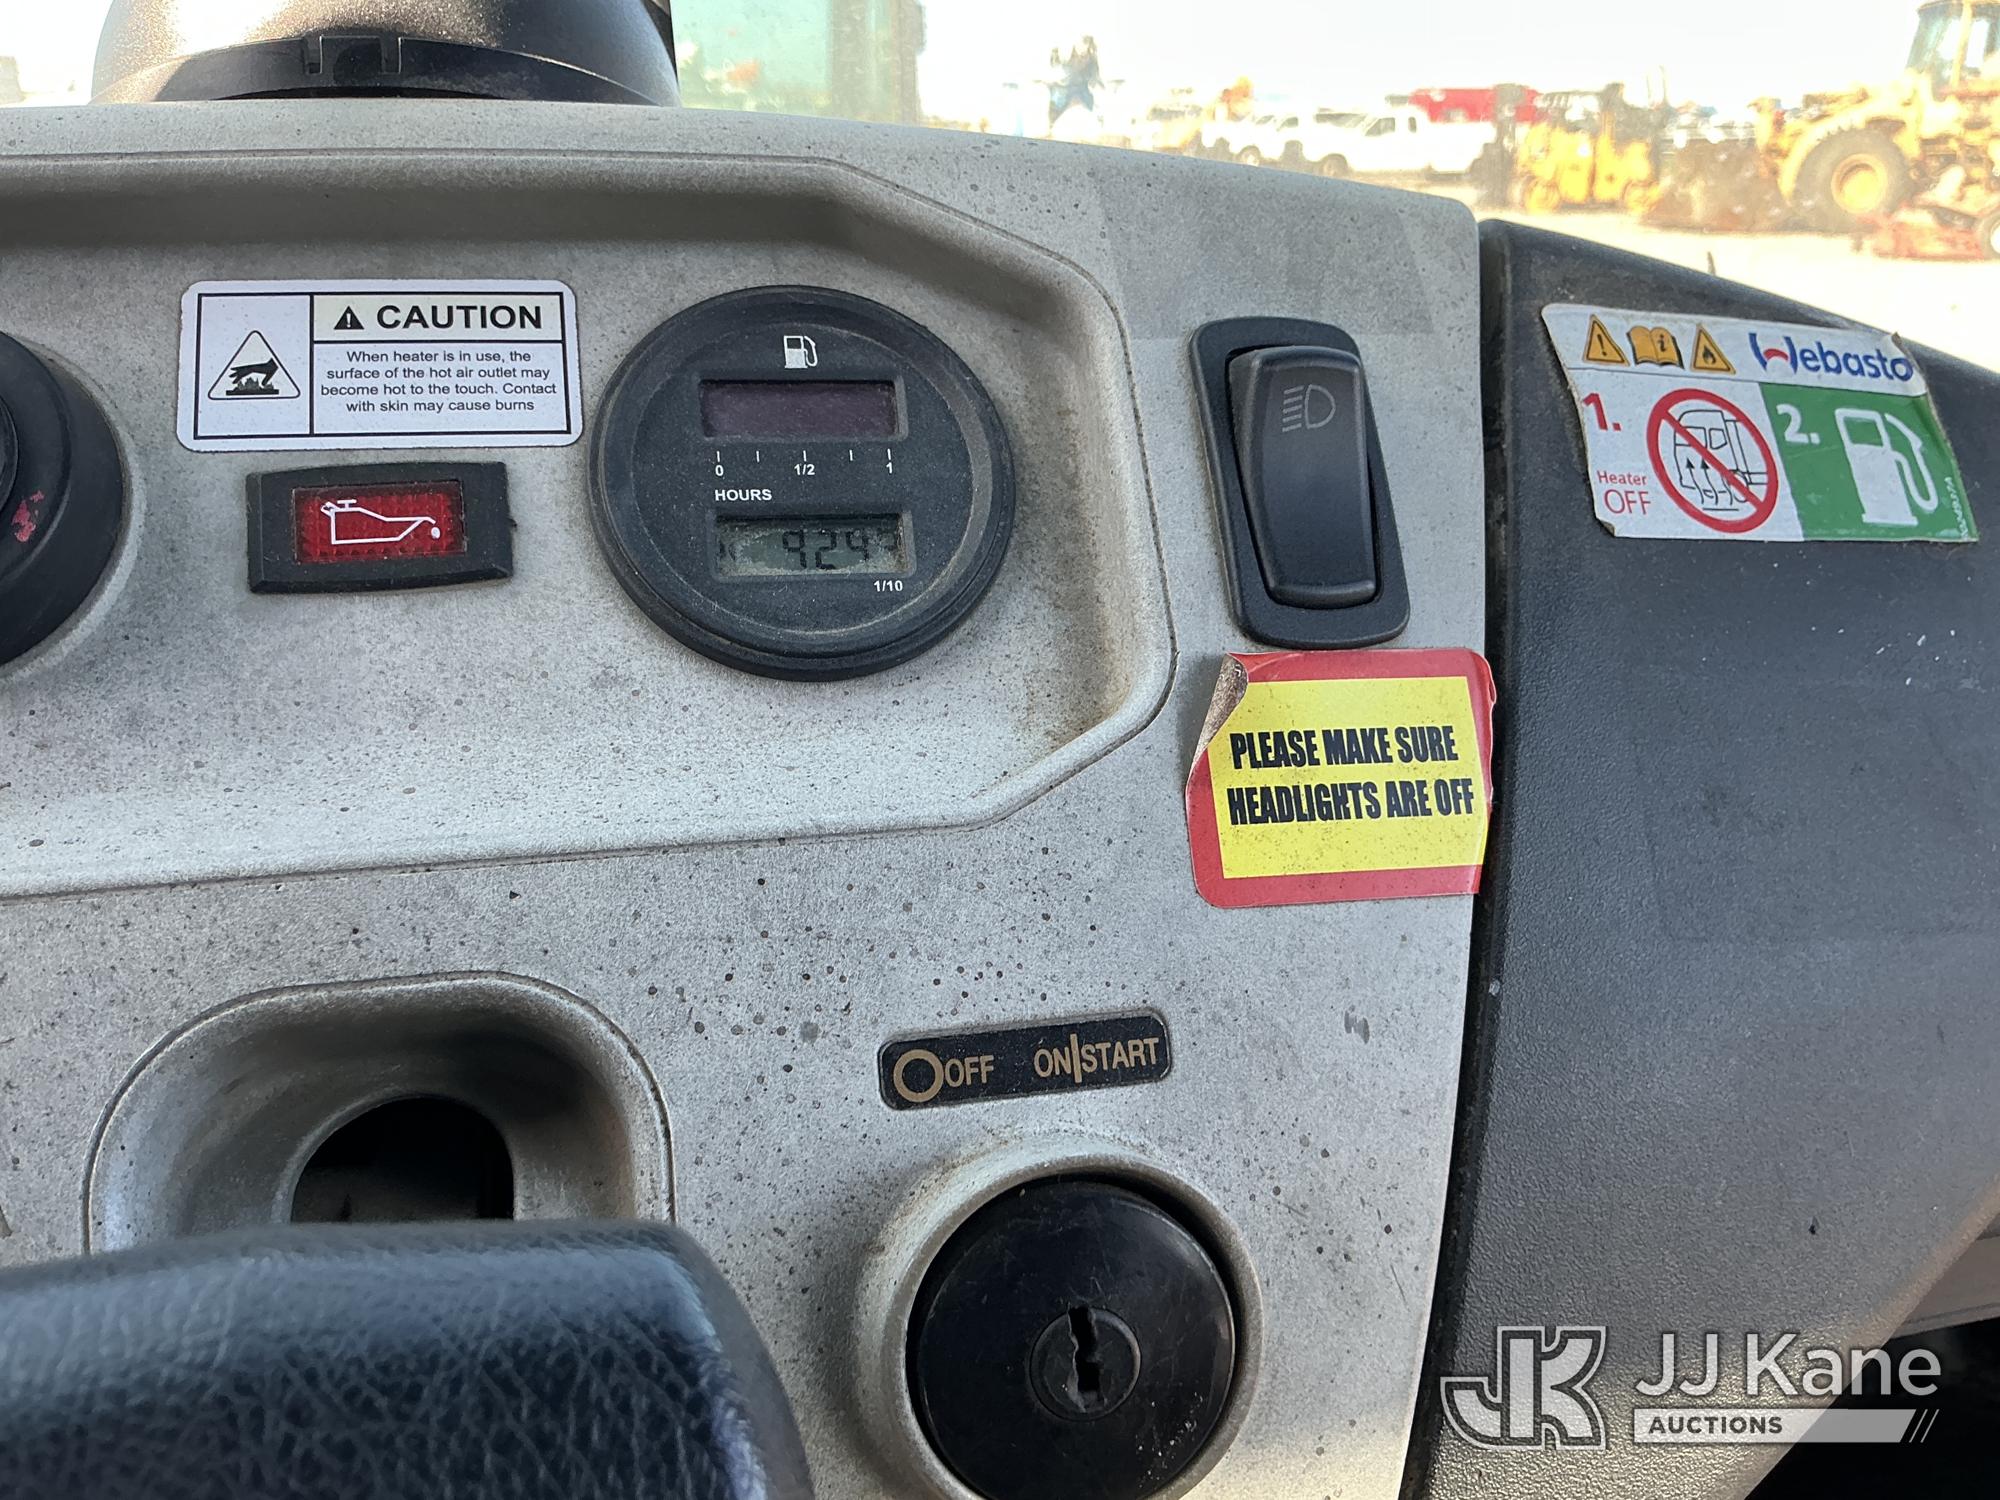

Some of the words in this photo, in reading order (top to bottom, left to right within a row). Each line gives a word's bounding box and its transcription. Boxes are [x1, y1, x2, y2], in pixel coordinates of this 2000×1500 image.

[376, 304, 542, 330] CAUTION
[346, 350, 389, 362] When
[393, 350, 439, 362] heater
[443, 350, 455, 361] is
[459, 350, 471, 361] in
[475, 352, 505, 363] use,
[510, 350, 531, 361] the
[1748, 332, 1914, 382] Webasto
[326, 367, 380, 379] surface
[384, 366, 400, 379] of
[402, 367, 425, 378] the
[429, 366, 452, 378] hot
[456, 366, 474, 378] air
[478, 366, 518, 378] outlet
[521, 369, 550, 381] may
[320, 383, 379, 395] become
[383, 383, 406, 395] hot
[410, 383, 424, 395] to
[428, 383, 451, 395] the
[455, 383, 498, 394] touch.
[502, 382, 558, 394] Contact
[346, 400, 375, 412] with
[380, 400, 409, 412] skin
[414, 402, 444, 414] may
[448, 401, 491, 411] cause
[495, 399, 535, 411] burns
[1582, 391, 1622, 432] 1.
[1775, 402, 1821, 445] 2.
[714, 464, 725, 477] 0
[793, 463, 816, 476] 1/2
[885, 462, 893, 474] 1
[1596, 469, 1648, 486] Heater
[714, 488, 773, 501] HOURS
[1604, 488, 1652, 516] OFF
[873, 580, 904, 592] 1/10
[1229, 729, 1321, 769] PLEASE
[1321, 727, 1393, 766] MAKE
[1394, 725, 1458, 764] SURE
[1226, 781, 1381, 826] HEADLIGHTS
[1385, 779, 1433, 818] ARE
[1433, 777, 1475, 816] OFF
[944, 1054, 995, 1088] OFF
